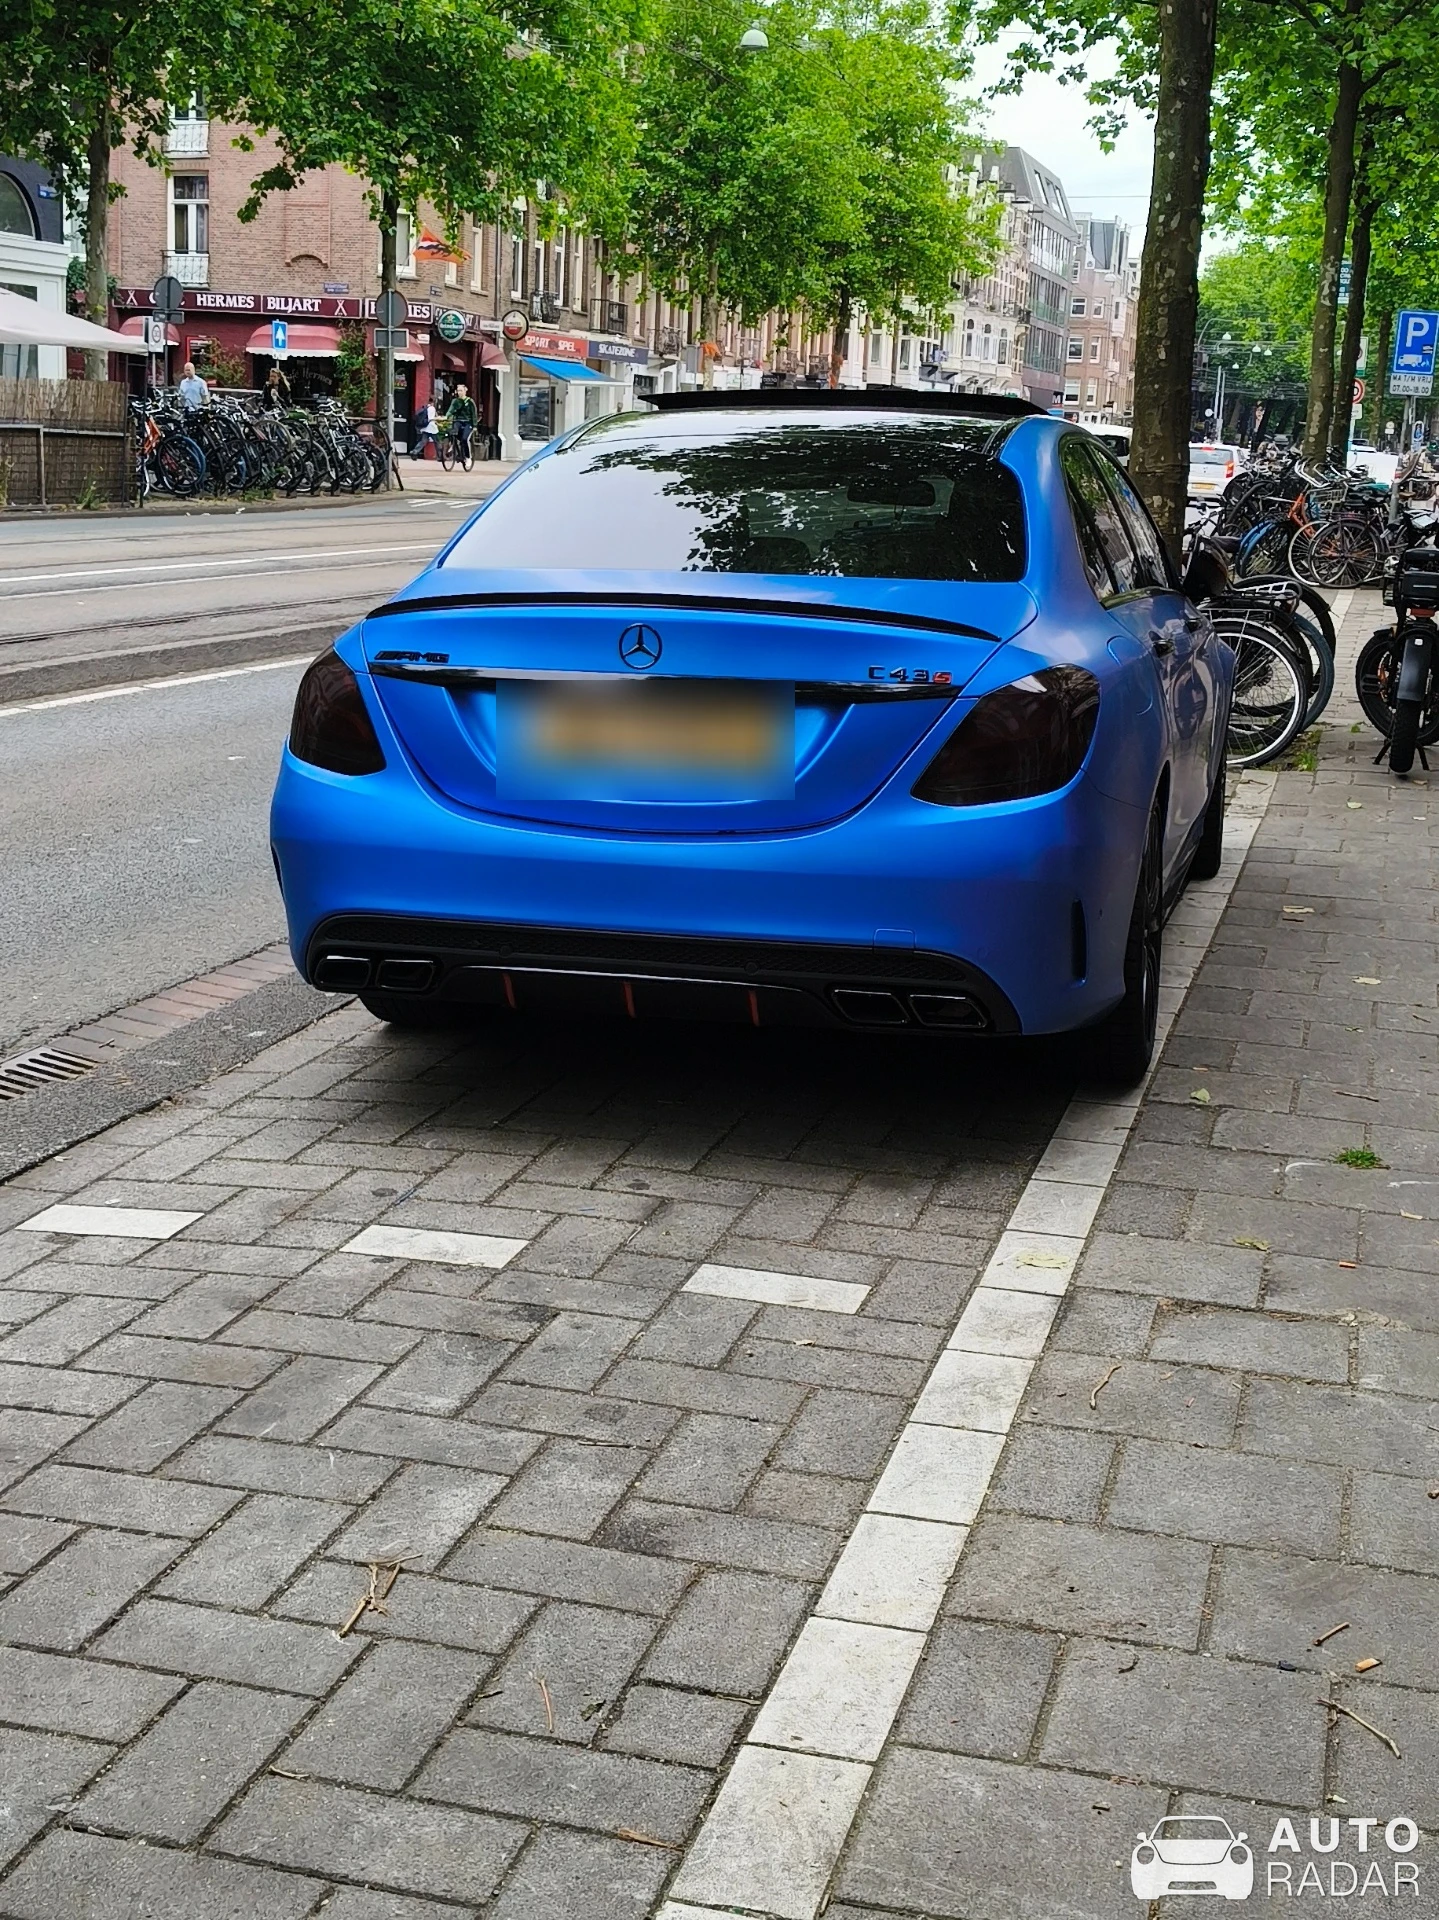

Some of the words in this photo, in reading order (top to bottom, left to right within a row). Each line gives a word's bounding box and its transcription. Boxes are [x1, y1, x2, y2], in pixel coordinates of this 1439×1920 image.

[196, 293, 255, 308] HERMES
[266, 296, 321, 313] BILJART
[1405, 316, 1430, 348] P
[557, 340, 576, 352] SPEL
[598, 343, 636, 357] SKATEZONE
